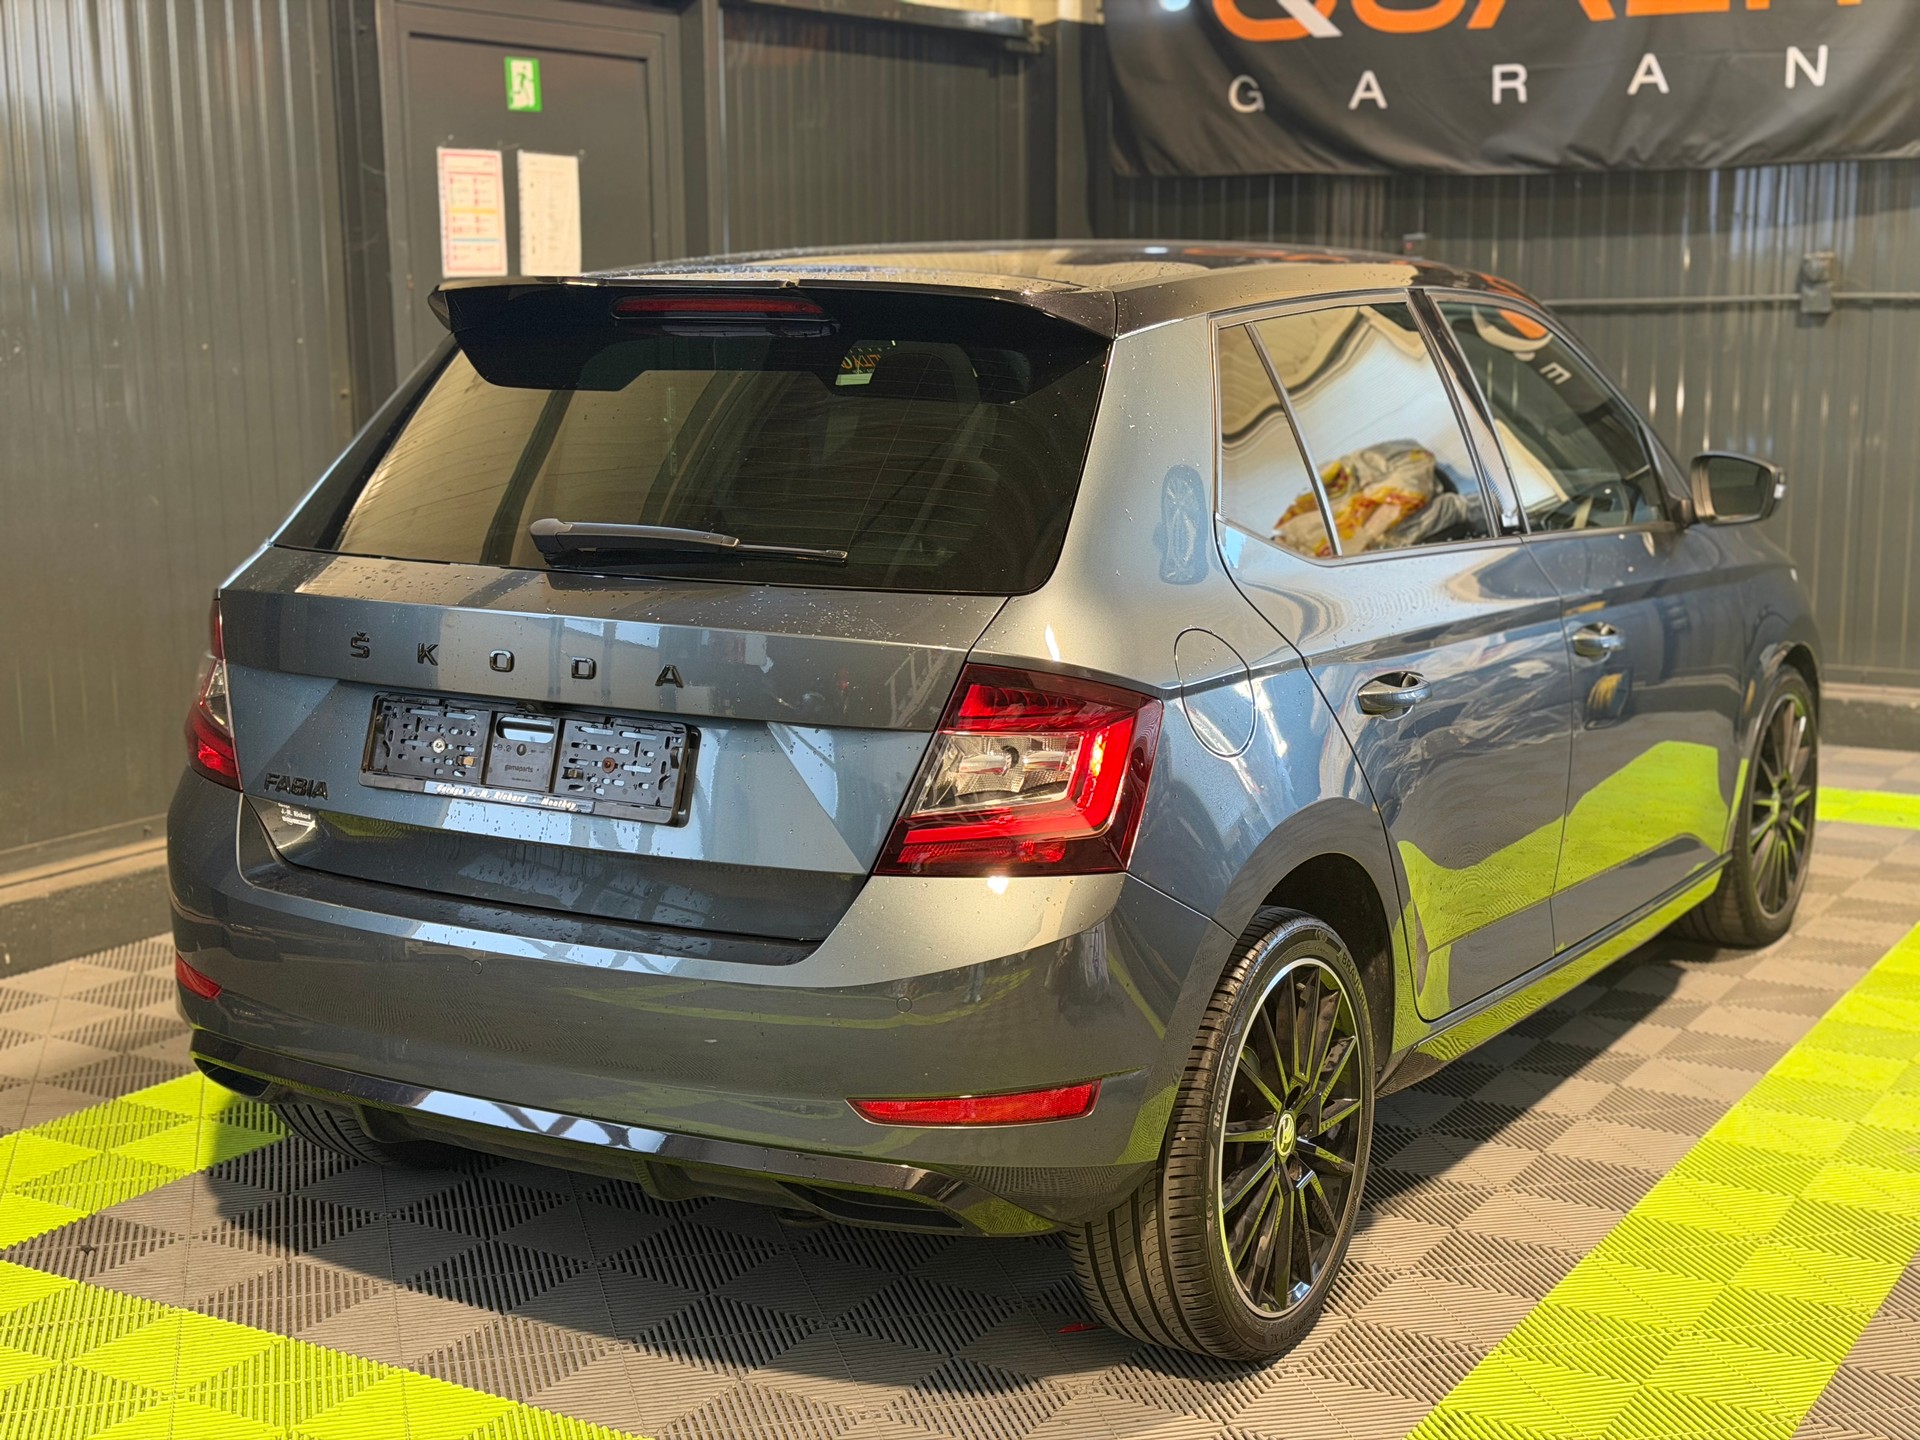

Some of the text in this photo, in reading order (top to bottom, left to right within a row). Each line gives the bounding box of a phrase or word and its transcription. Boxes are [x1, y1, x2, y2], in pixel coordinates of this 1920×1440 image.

[350, 631, 684, 689] ŠKODA
[263, 773, 329, 800] FABIA
[436, 784, 465, 796] Garage
[493, 791, 528, 803] Richard
